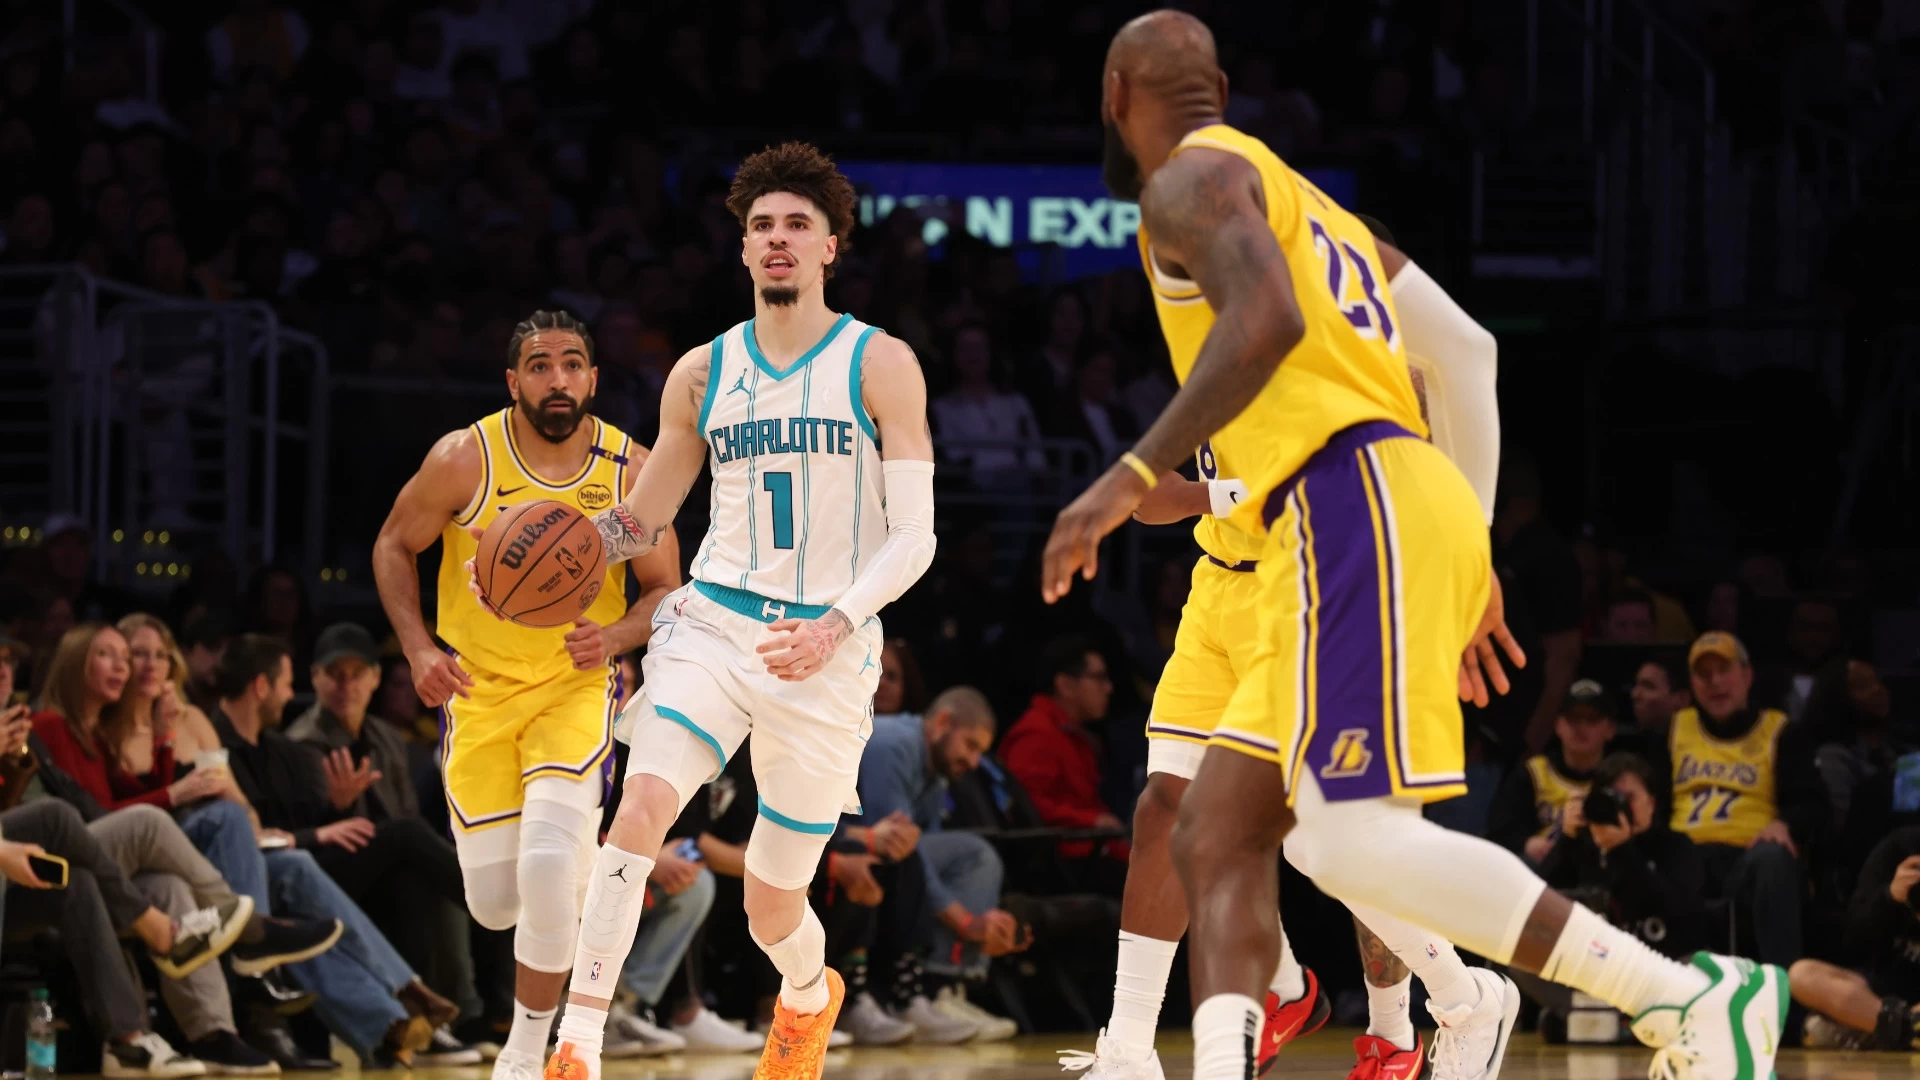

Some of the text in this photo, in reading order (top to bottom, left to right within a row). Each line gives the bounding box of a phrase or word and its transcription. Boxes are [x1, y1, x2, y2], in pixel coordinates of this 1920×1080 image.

[1028, 196, 1141, 249] EXP
[709, 417, 853, 464] CHARLOTTE
[580, 490, 610, 502] bibigo
[763, 471, 794, 550] 1
[500, 508, 571, 569] Wilson
[1676, 755, 1758, 787] LAKERS
[1687, 787, 1742, 825] 77
